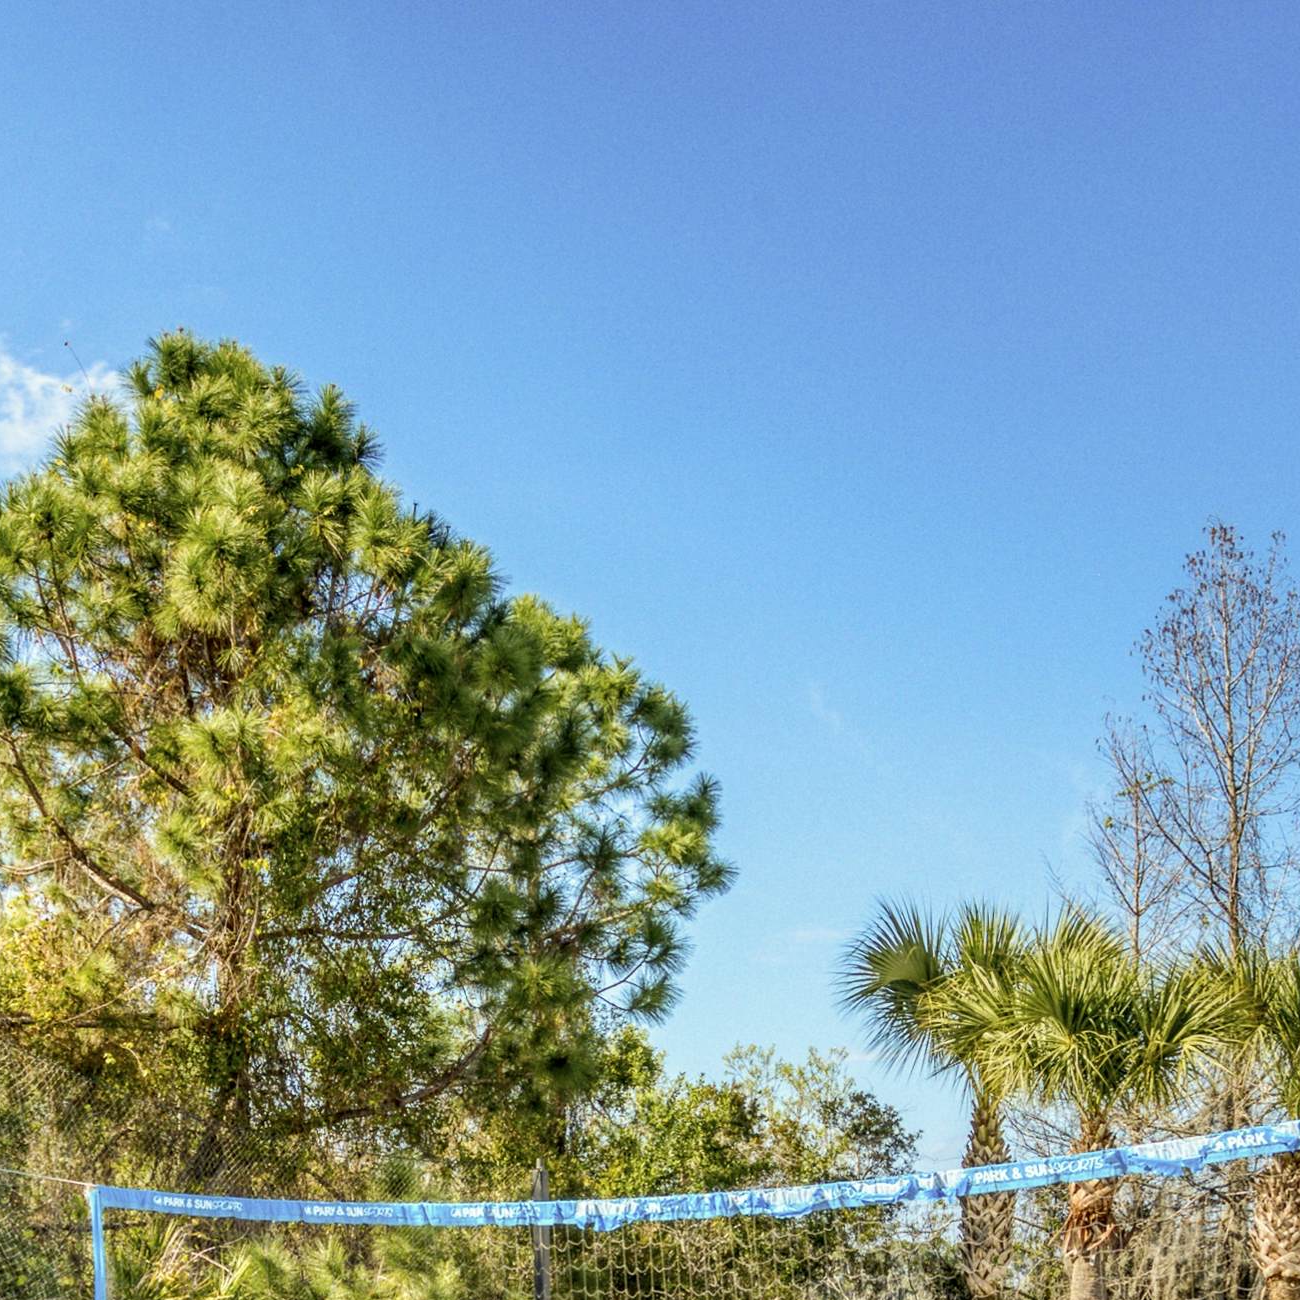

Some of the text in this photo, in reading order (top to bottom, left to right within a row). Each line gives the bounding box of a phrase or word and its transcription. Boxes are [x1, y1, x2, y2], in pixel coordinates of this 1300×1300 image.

[1227, 1131, 1267, 1150] PARK
[974, 1169, 1009, 1185] PARK
[1012, 1167, 1022, 1180] &
[164, 1196, 185, 1208] PARK
